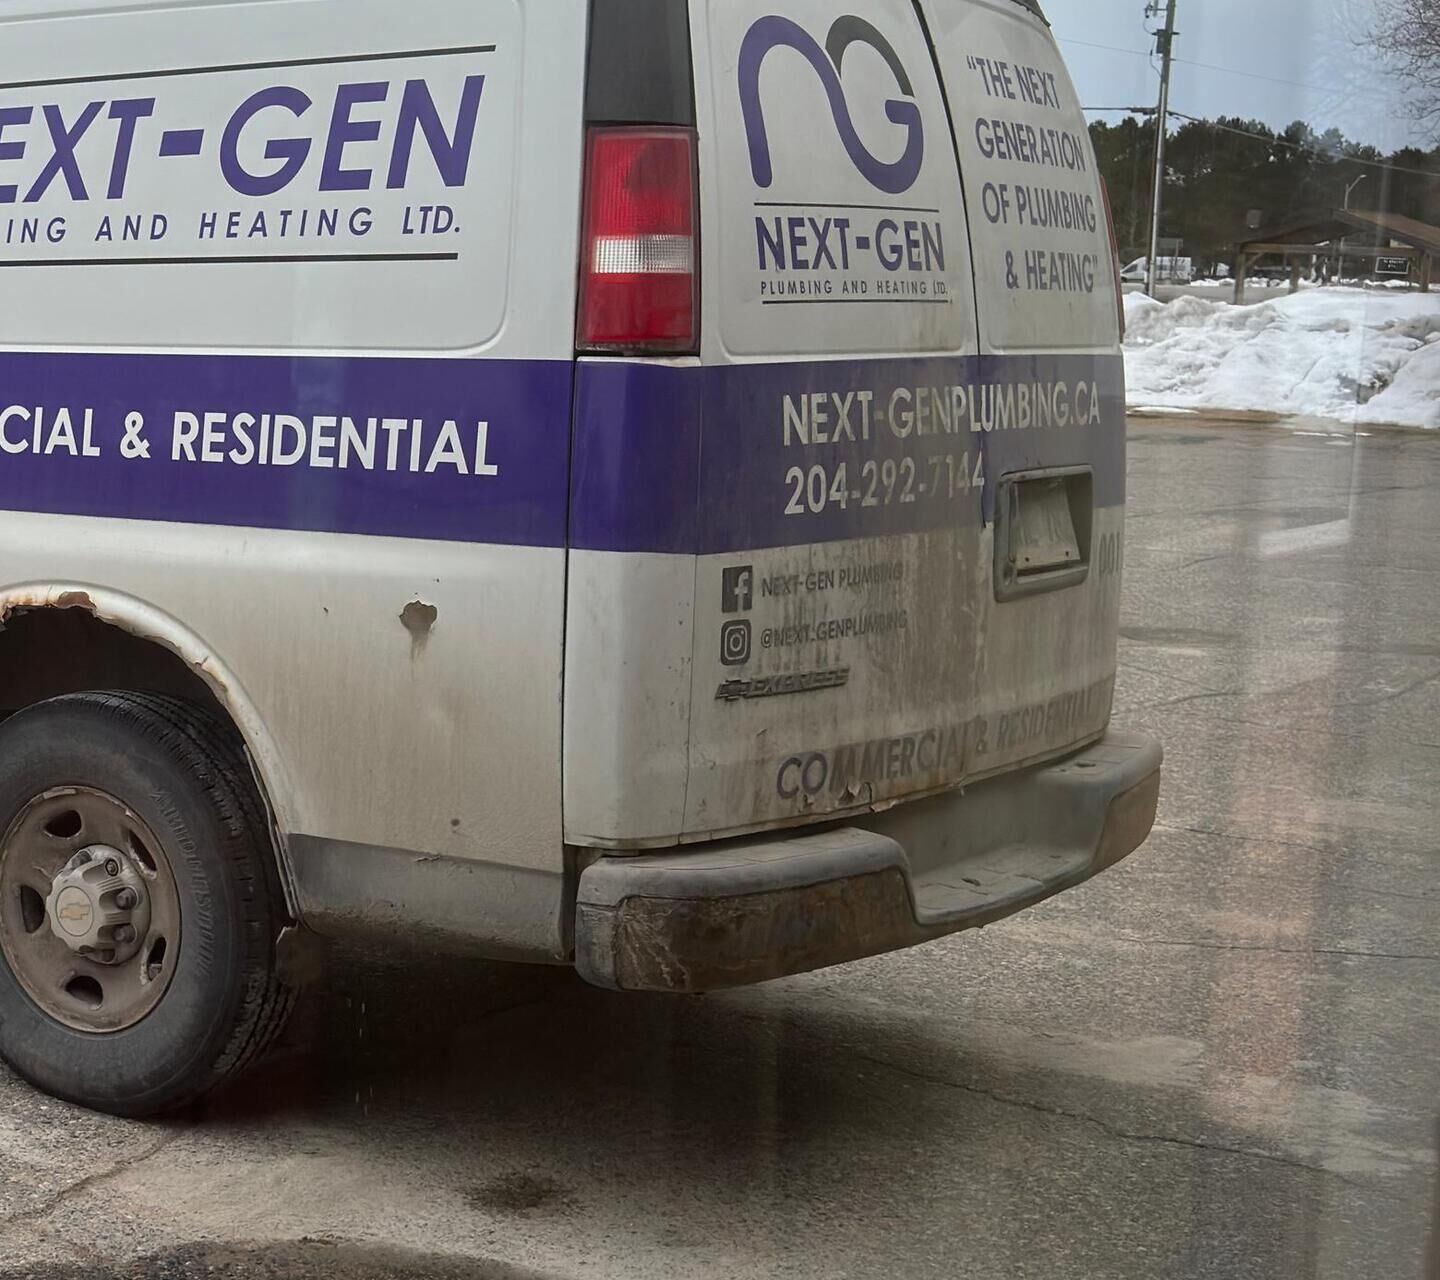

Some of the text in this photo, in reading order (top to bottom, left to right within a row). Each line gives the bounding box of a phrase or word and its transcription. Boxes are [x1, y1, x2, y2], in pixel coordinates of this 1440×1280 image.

[1014, 64, 1061, 110] NEXT
[975, 117, 1086, 172] GENERATION
[94, 213, 168, 242] AND
[198, 207, 374, 241] HEATING
[401, 204, 461, 236] LTD.
[982, 182, 1097, 234] OF PLUMBING
[754, 216, 946, 272] NEXT-GEN
[761, 280, 833, 295] PLUMBING
[842, 280, 868, 295] AND
[876, 280, 927, 295] HEATING
[1005, 250, 1020, 289] &
[120, 410, 152, 460] &
[170, 410, 500, 477] RESIDENTIAL
[784, 451, 986, 516] 204-292-7144
[761, 570, 835, 598] NEXT-GEN
